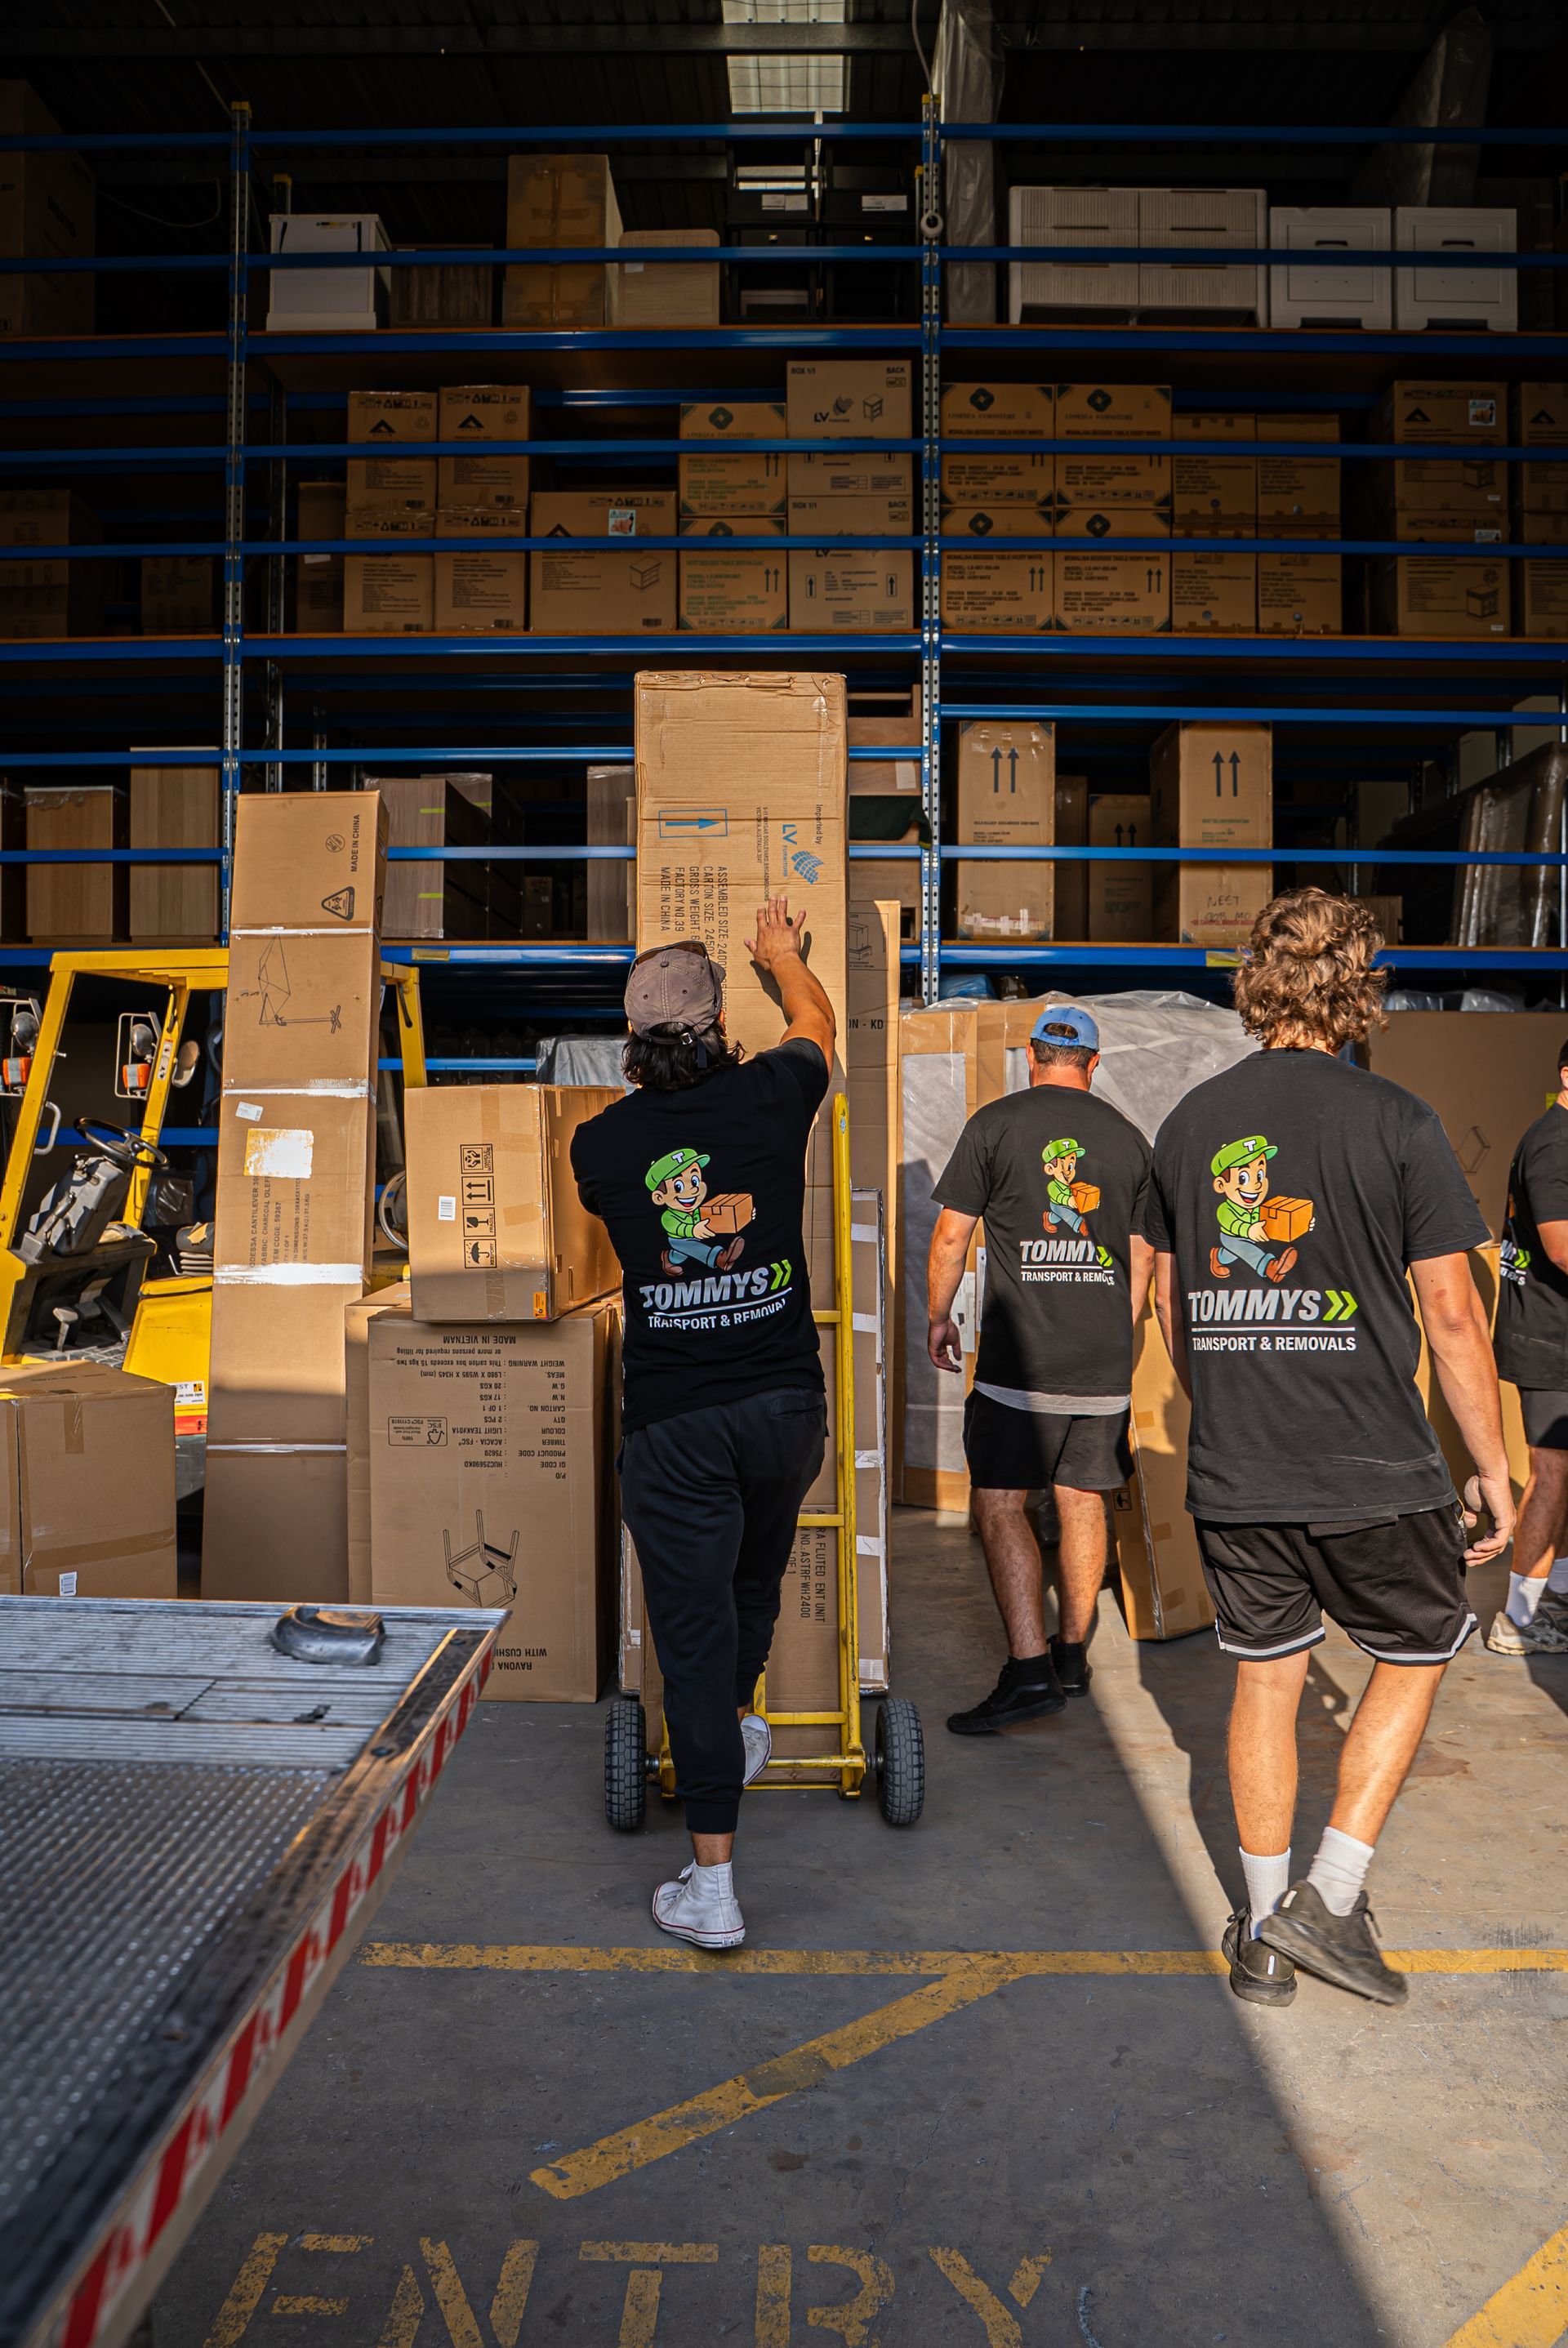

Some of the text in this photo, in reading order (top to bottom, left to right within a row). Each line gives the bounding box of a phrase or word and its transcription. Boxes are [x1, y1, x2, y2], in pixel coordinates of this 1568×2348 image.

[814, 412, 829, 422] LV
[814, 804, 822, 844] Imported by
[782, 824, 797, 845] LV
[661, 867, 670, 890] MADE
[675, 867, 684, 904] FACTORY
[689, 866, 699, 894] GROSS
[703, 866, 714, 924] CARTON SIZE:
[718, 867, 728, 942] ASSEMBLED SIZE:
[1207, 895, 1240, 907] NEST
[661, 906, 670, 931] CHINA
[871, 1019, 883, 1029] KD
[1062, 1141, 1070, 1149] T
[1243, 1140, 1256, 1152] T
[672, 1152, 685, 1164] T
[251, 1187, 259, 1234] CANTILEVER
[285, 1239, 289, 1247] OF
[1020, 1240, 1099, 1263] TOMMY
[1021, 1272, 1074, 1282] TRANSPORT
[1074, 1272, 1082, 1282] &
[639, 1267, 769, 1310] TOMMYS
[1188, 1290, 1321, 1321] TOMMYS
[720, 1316, 731, 1327] &
[443, 1335, 516, 1343] MADE IN VIETNAM
[1192, 1337, 1356, 1351] TRANSPORT & REMOVALS
[801, 1510, 810, 1530] IM
[787, 1557, 796, 1567] OF
[815, 1509, 825, 1622] ARA FLUTED ENT UNIT
[495, 1648, 547, 1656] WITH CUSHI
[498, 1662, 532, 1670] RAVONA
[203, 2232, 1052, 2348] ENTRY
